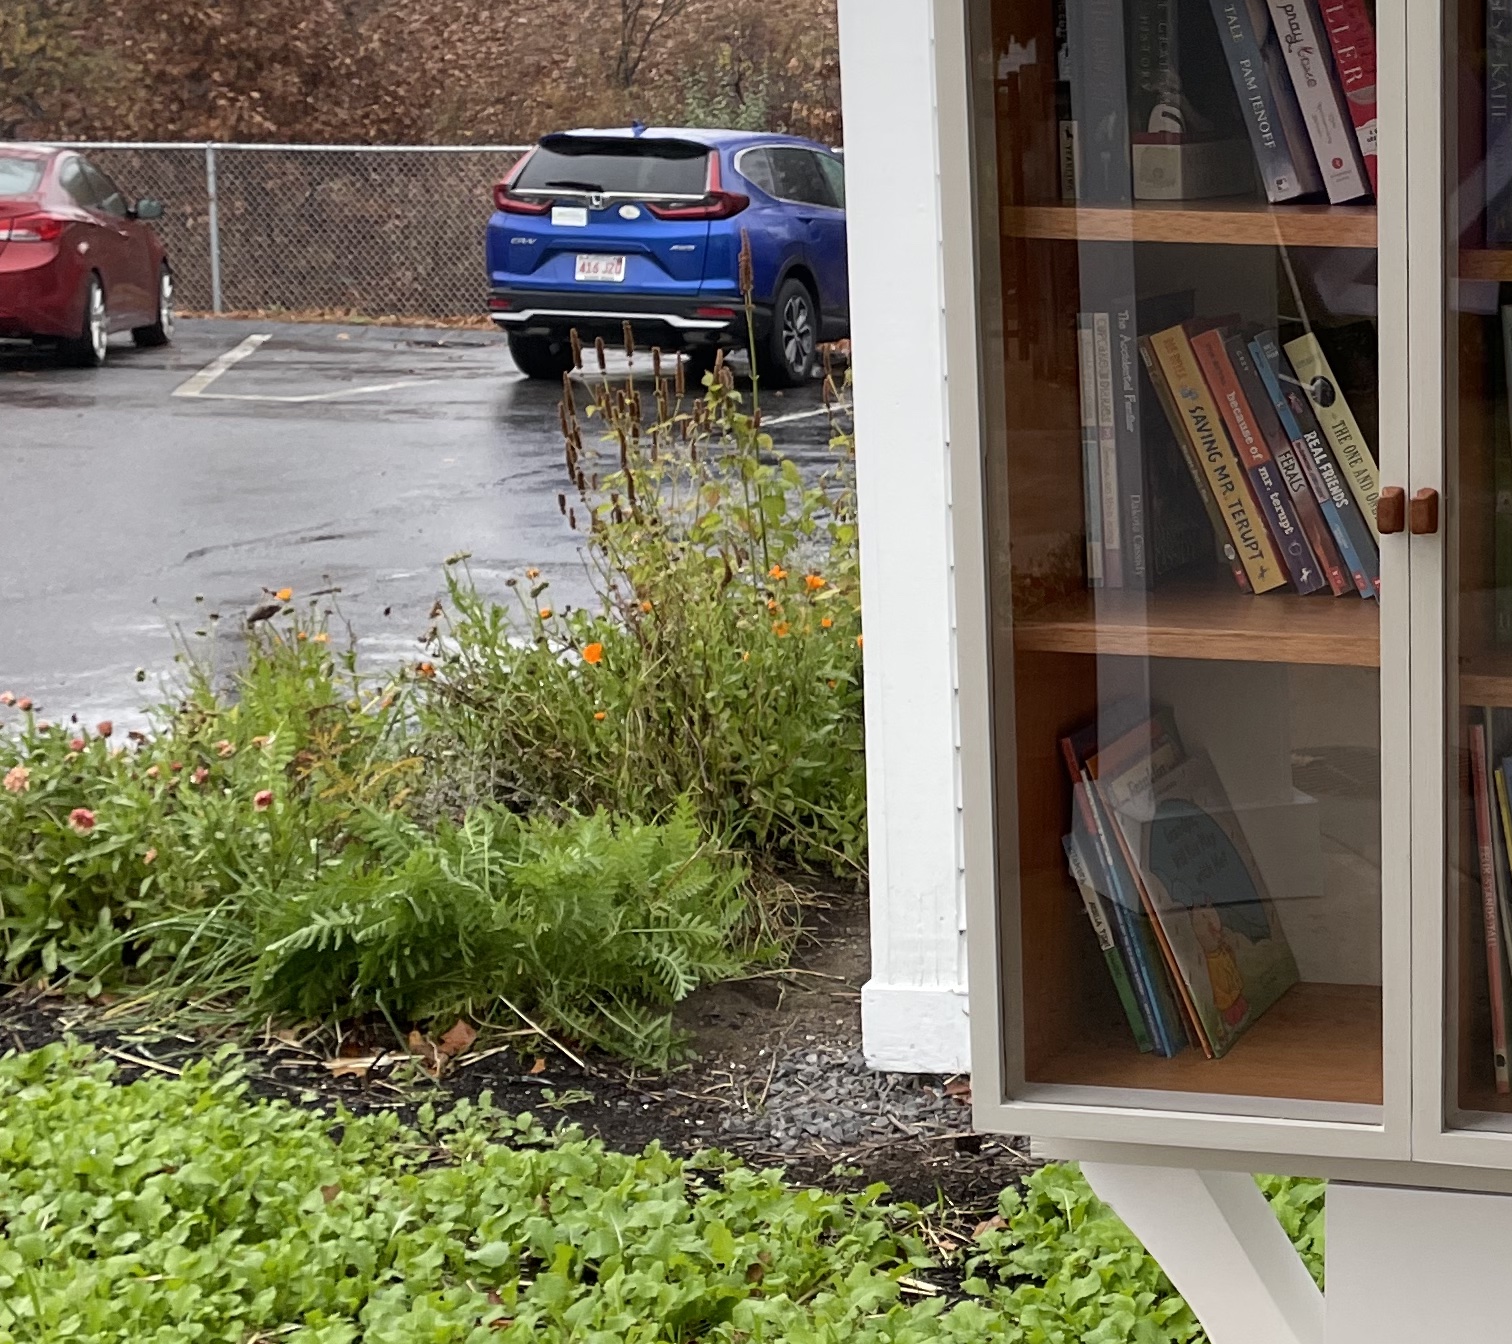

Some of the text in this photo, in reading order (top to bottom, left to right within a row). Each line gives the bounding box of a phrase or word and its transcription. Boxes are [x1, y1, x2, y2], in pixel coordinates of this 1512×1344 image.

[1276, 0, 1309, 53] pray
[1139, 15, 1152, 92] HISTORY
[1223, 4, 1244, 43] TALE
[1239, 58, 1259, 92] PAM
[1249, 94, 1277, 151] JENOFF
[1117, 310, 1129, 330] The
[1330, 419, 1354, 446] THE
[1341, 443, 1365, 469] ONE
[1187, 403, 1225, 465] SAVING
[1226, 498, 1264, 563] TERUPT
[1225, 390, 1296, 537] because of mr. terupt
[1276, 449, 1307, 494] FERALS
[1302, 429, 1330, 466] REAL
[1318, 461, 1350, 510] FRIENDS
[1352, 467, 1376, 493] AND
[1129, 494, 1142, 533] Dakota
